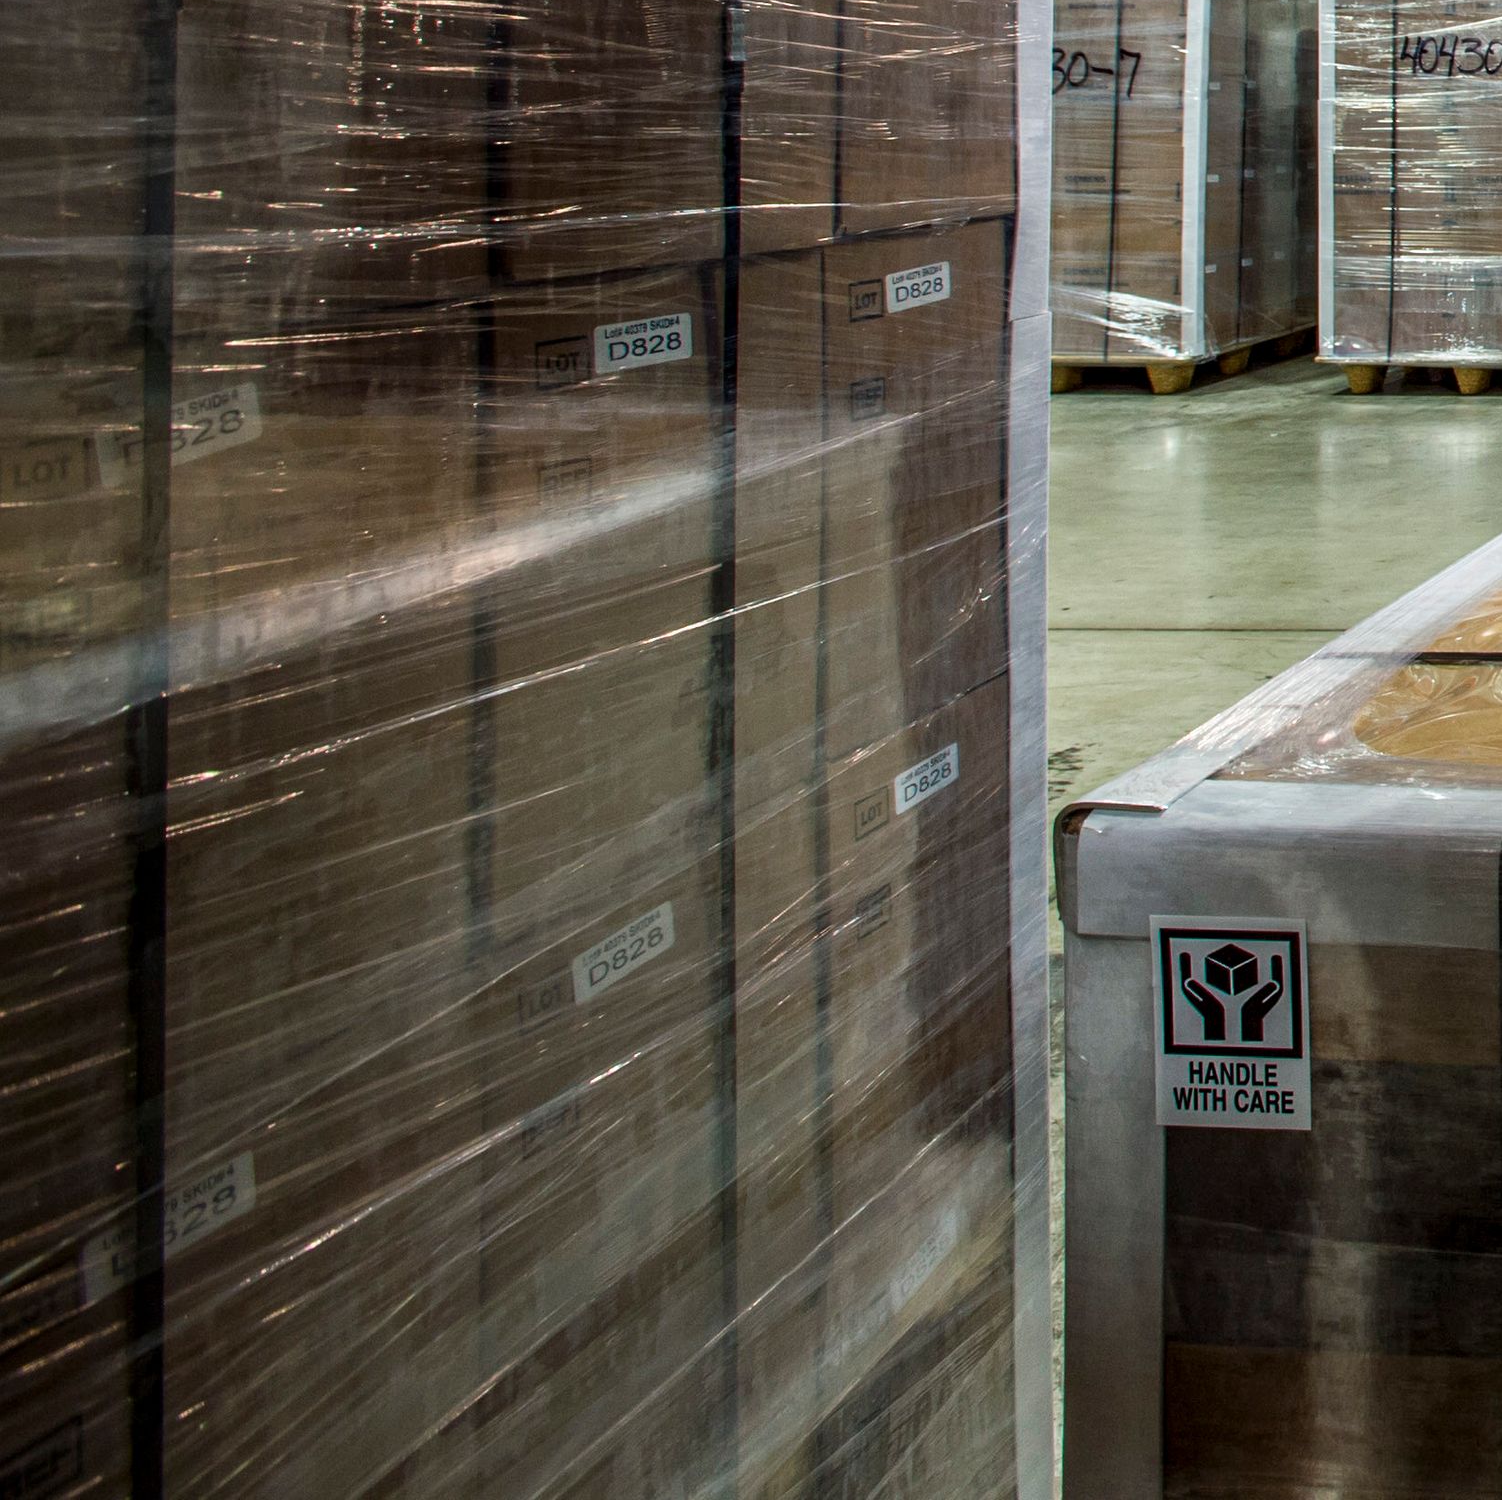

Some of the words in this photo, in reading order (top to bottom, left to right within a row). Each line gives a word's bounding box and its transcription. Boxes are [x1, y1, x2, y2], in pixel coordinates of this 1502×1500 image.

[855, 292, 877, 311] LOT
[895, 277, 944, 303] D828
[604, 328, 623, 339] Lot#
[624, 322, 647, 336] 40379
[608, 332, 682, 362] D828
[904, 762, 952, 803] D828
[861, 801, 883, 827] LOT
[589, 926, 663, 987] D828
[1188, 1061, 1278, 1087] HANDLE
[1173, 1087, 1227, 1112] WITH
[1234, 1089, 1295, 1114] CARE
